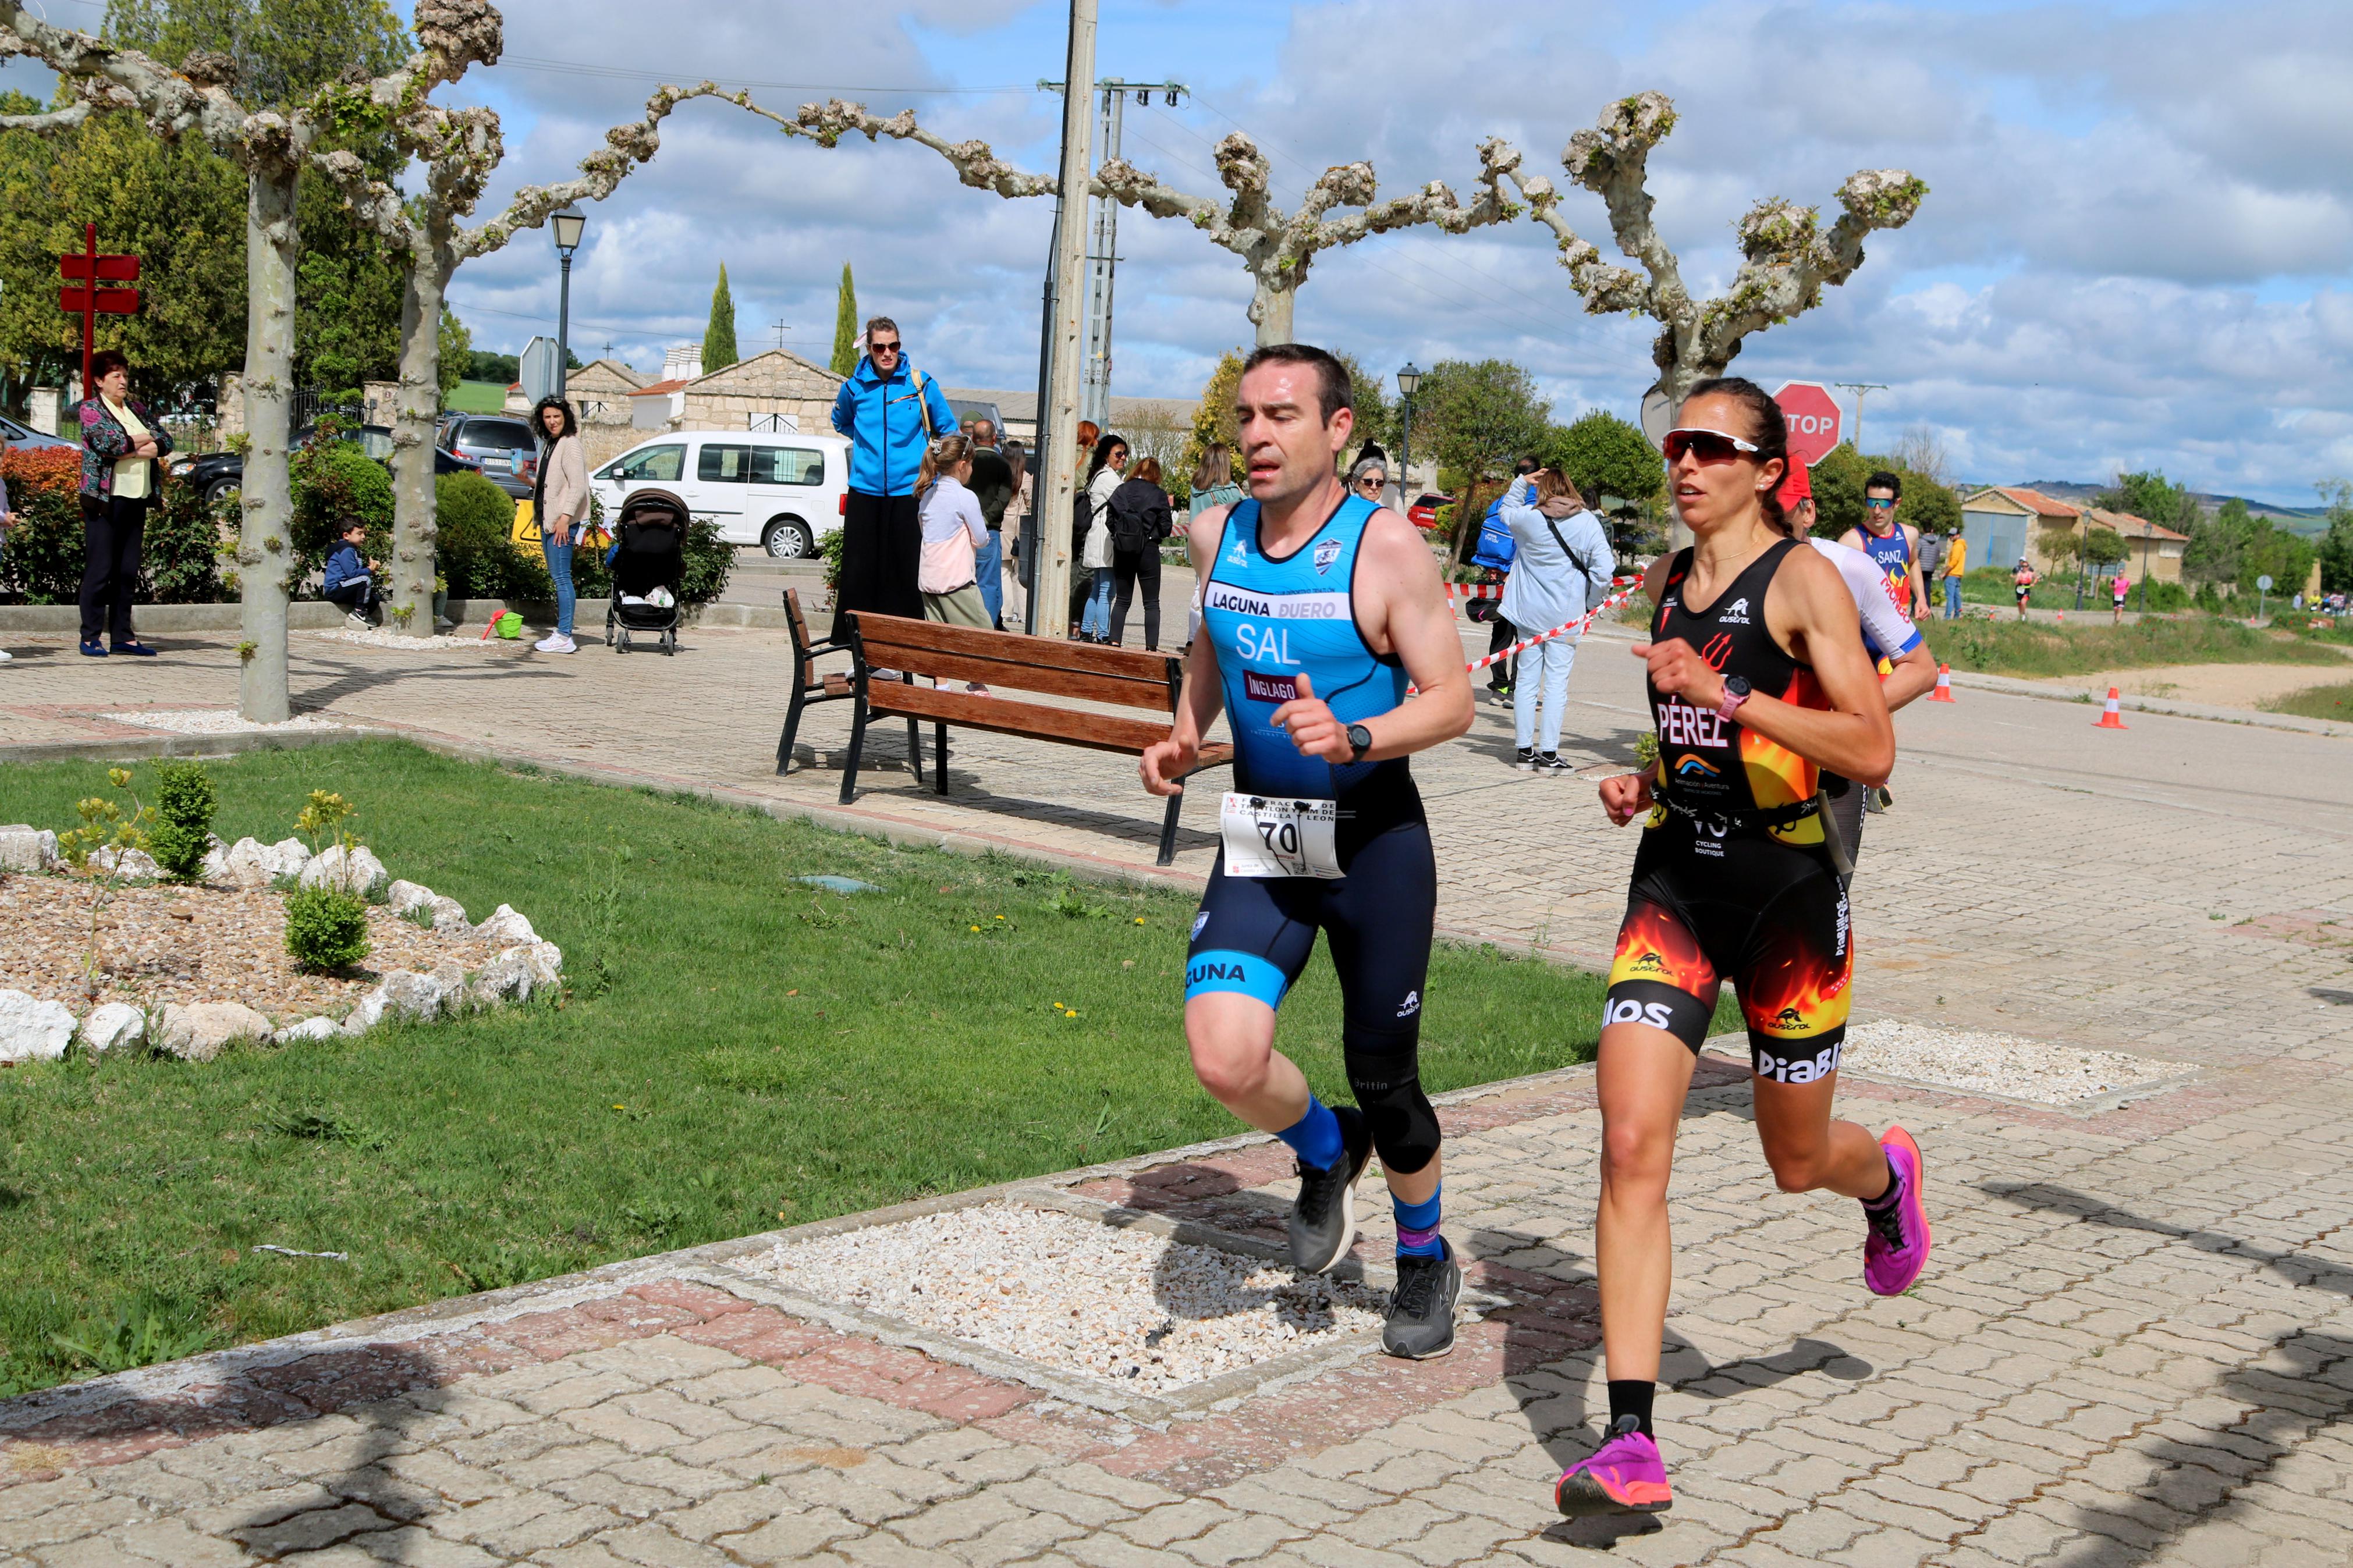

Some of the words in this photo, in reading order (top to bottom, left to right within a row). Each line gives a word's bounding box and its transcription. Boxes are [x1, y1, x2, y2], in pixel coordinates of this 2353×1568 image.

[1781, 414, 1834, 435] TOP
[1878, 549, 1902, 564] SANZ
[1213, 592, 1270, 617] LAGUNA
[1278, 602, 1336, 618] DUERO
[1880, 577, 1911, 624] MUNDO
[1236, 623, 1301, 665] SAL
[1248, 674, 1296, 700] INGLAGO
[1657, 695, 1729, 747] PÉREZ
[1240, 809, 1291, 819] CASTILLA
[1258, 822, 1297, 854] 70
[1695, 840, 1722, 849] CYCLING
[1695, 847, 1724, 857] BOUTIQUE
[1630, 965, 1675, 977] austral
[1767, 1022, 1811, 1030] austral
